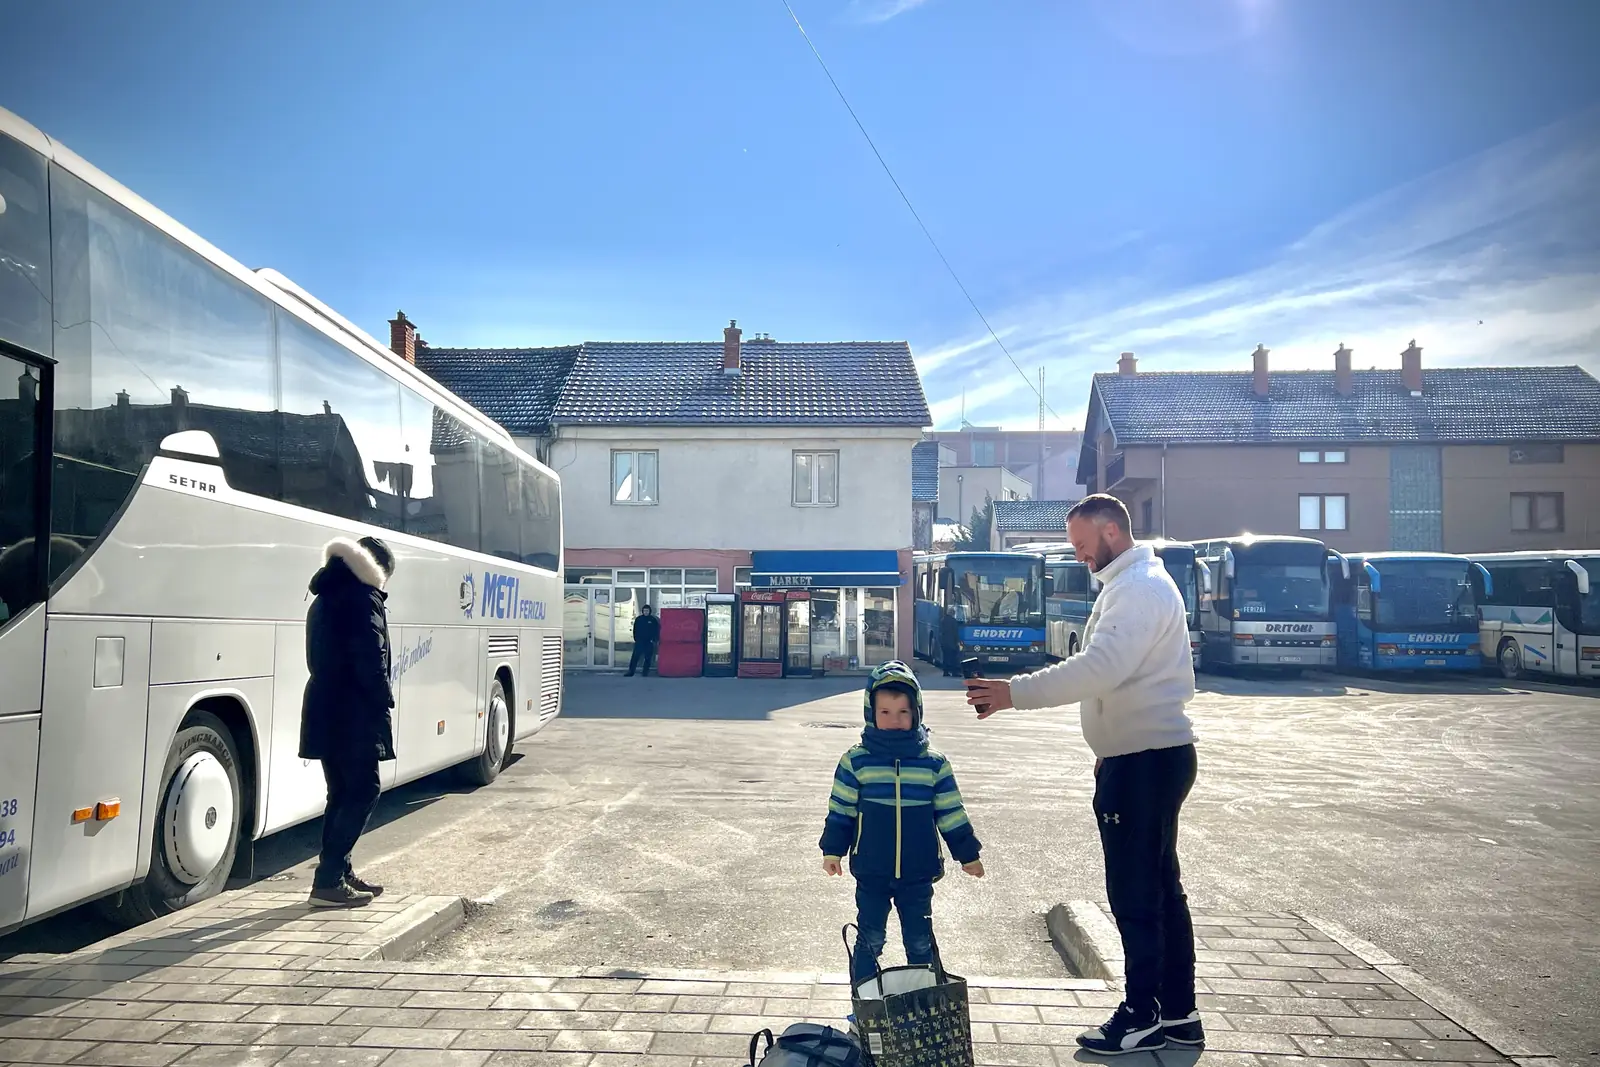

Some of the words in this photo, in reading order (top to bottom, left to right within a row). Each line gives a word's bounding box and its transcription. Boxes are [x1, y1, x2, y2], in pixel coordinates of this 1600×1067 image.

[169, 474, 216, 494] SETRA
[769, 576, 813, 586] MARKET
[481, 571, 520, 619] METI
[519, 599, 547, 620] FERIZAJ
[973, 629, 1024, 639] ENDRITI
[1408, 634, 1461, 643] ENDRITI
[0, 798, 18, 818] 38
